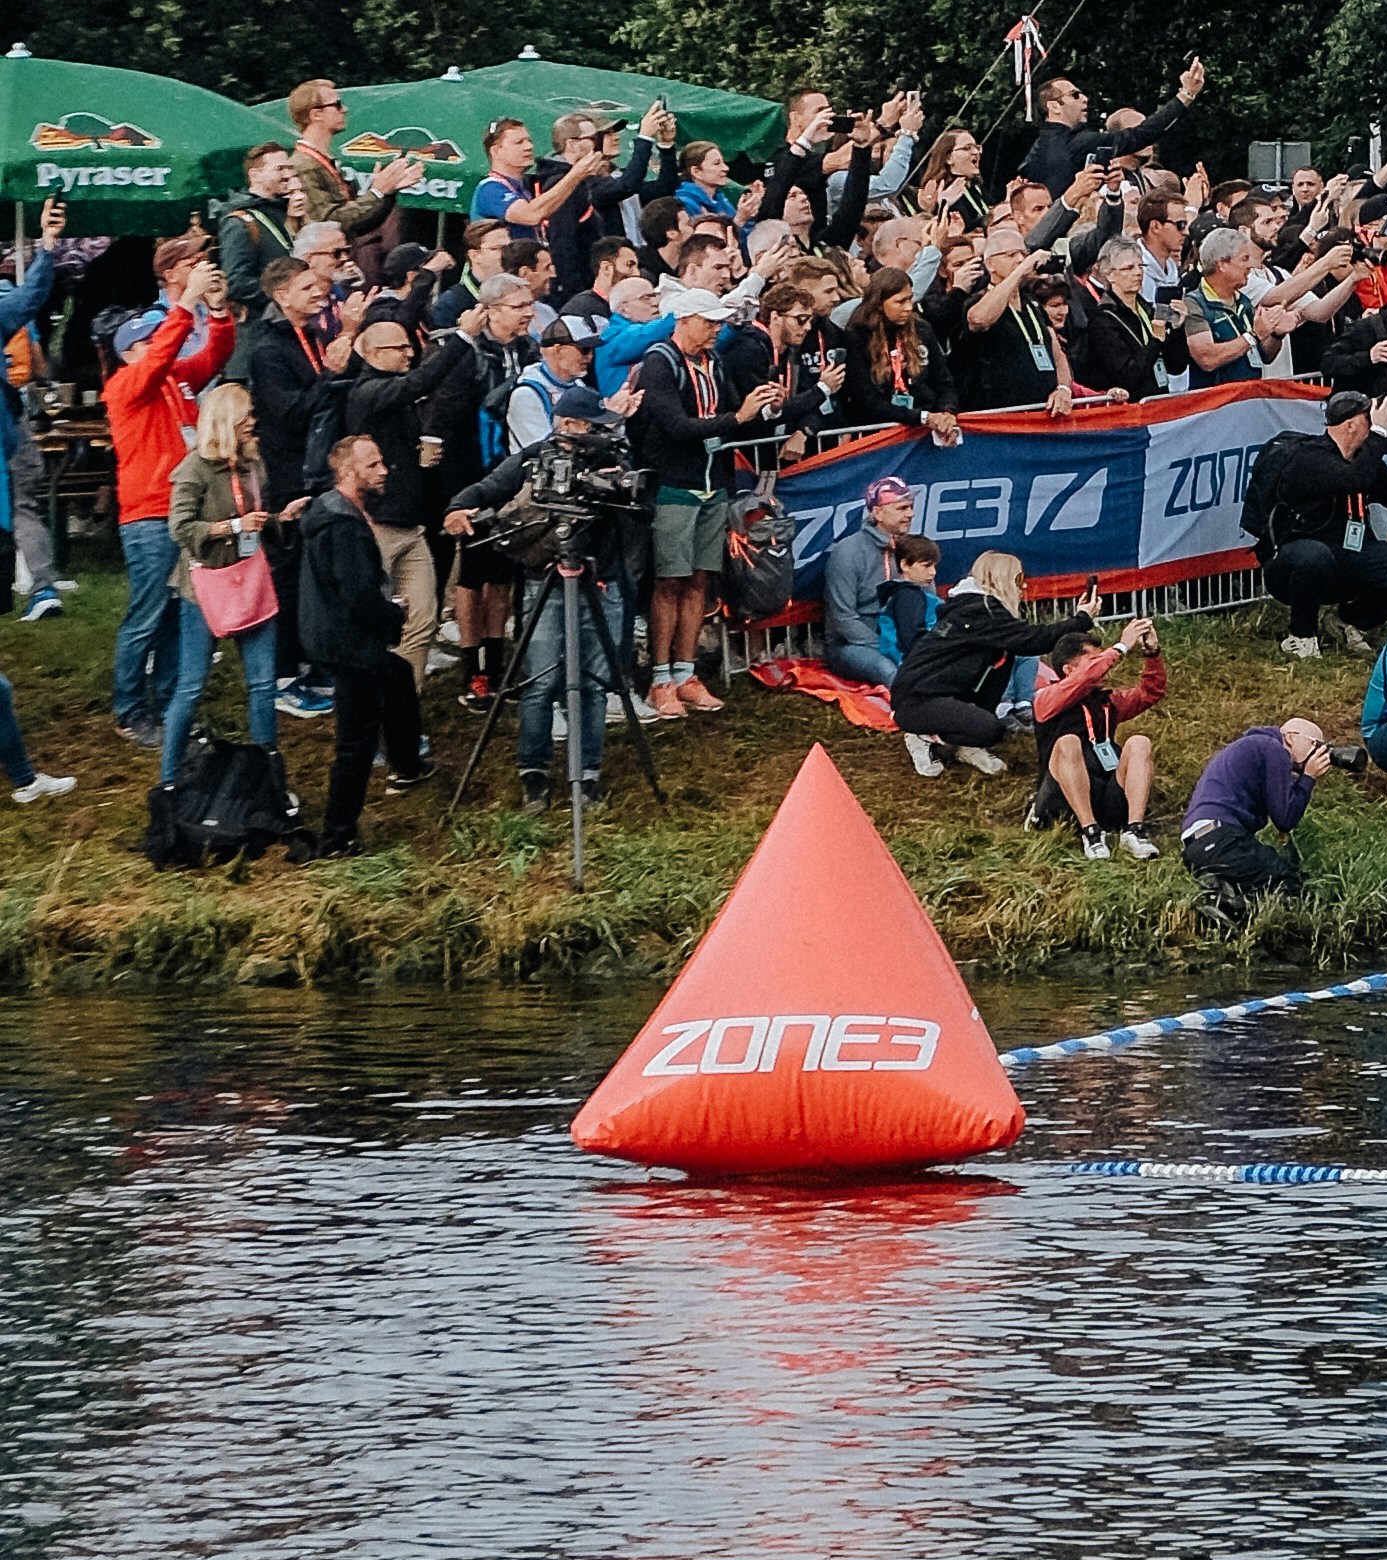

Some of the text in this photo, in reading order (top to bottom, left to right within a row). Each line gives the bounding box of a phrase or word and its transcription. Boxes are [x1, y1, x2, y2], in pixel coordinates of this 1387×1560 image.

[36, 163, 172, 192] Pyraser
[341, 166, 464, 198] Pyser
[641, 1013, 943, 1077] ZONE3
